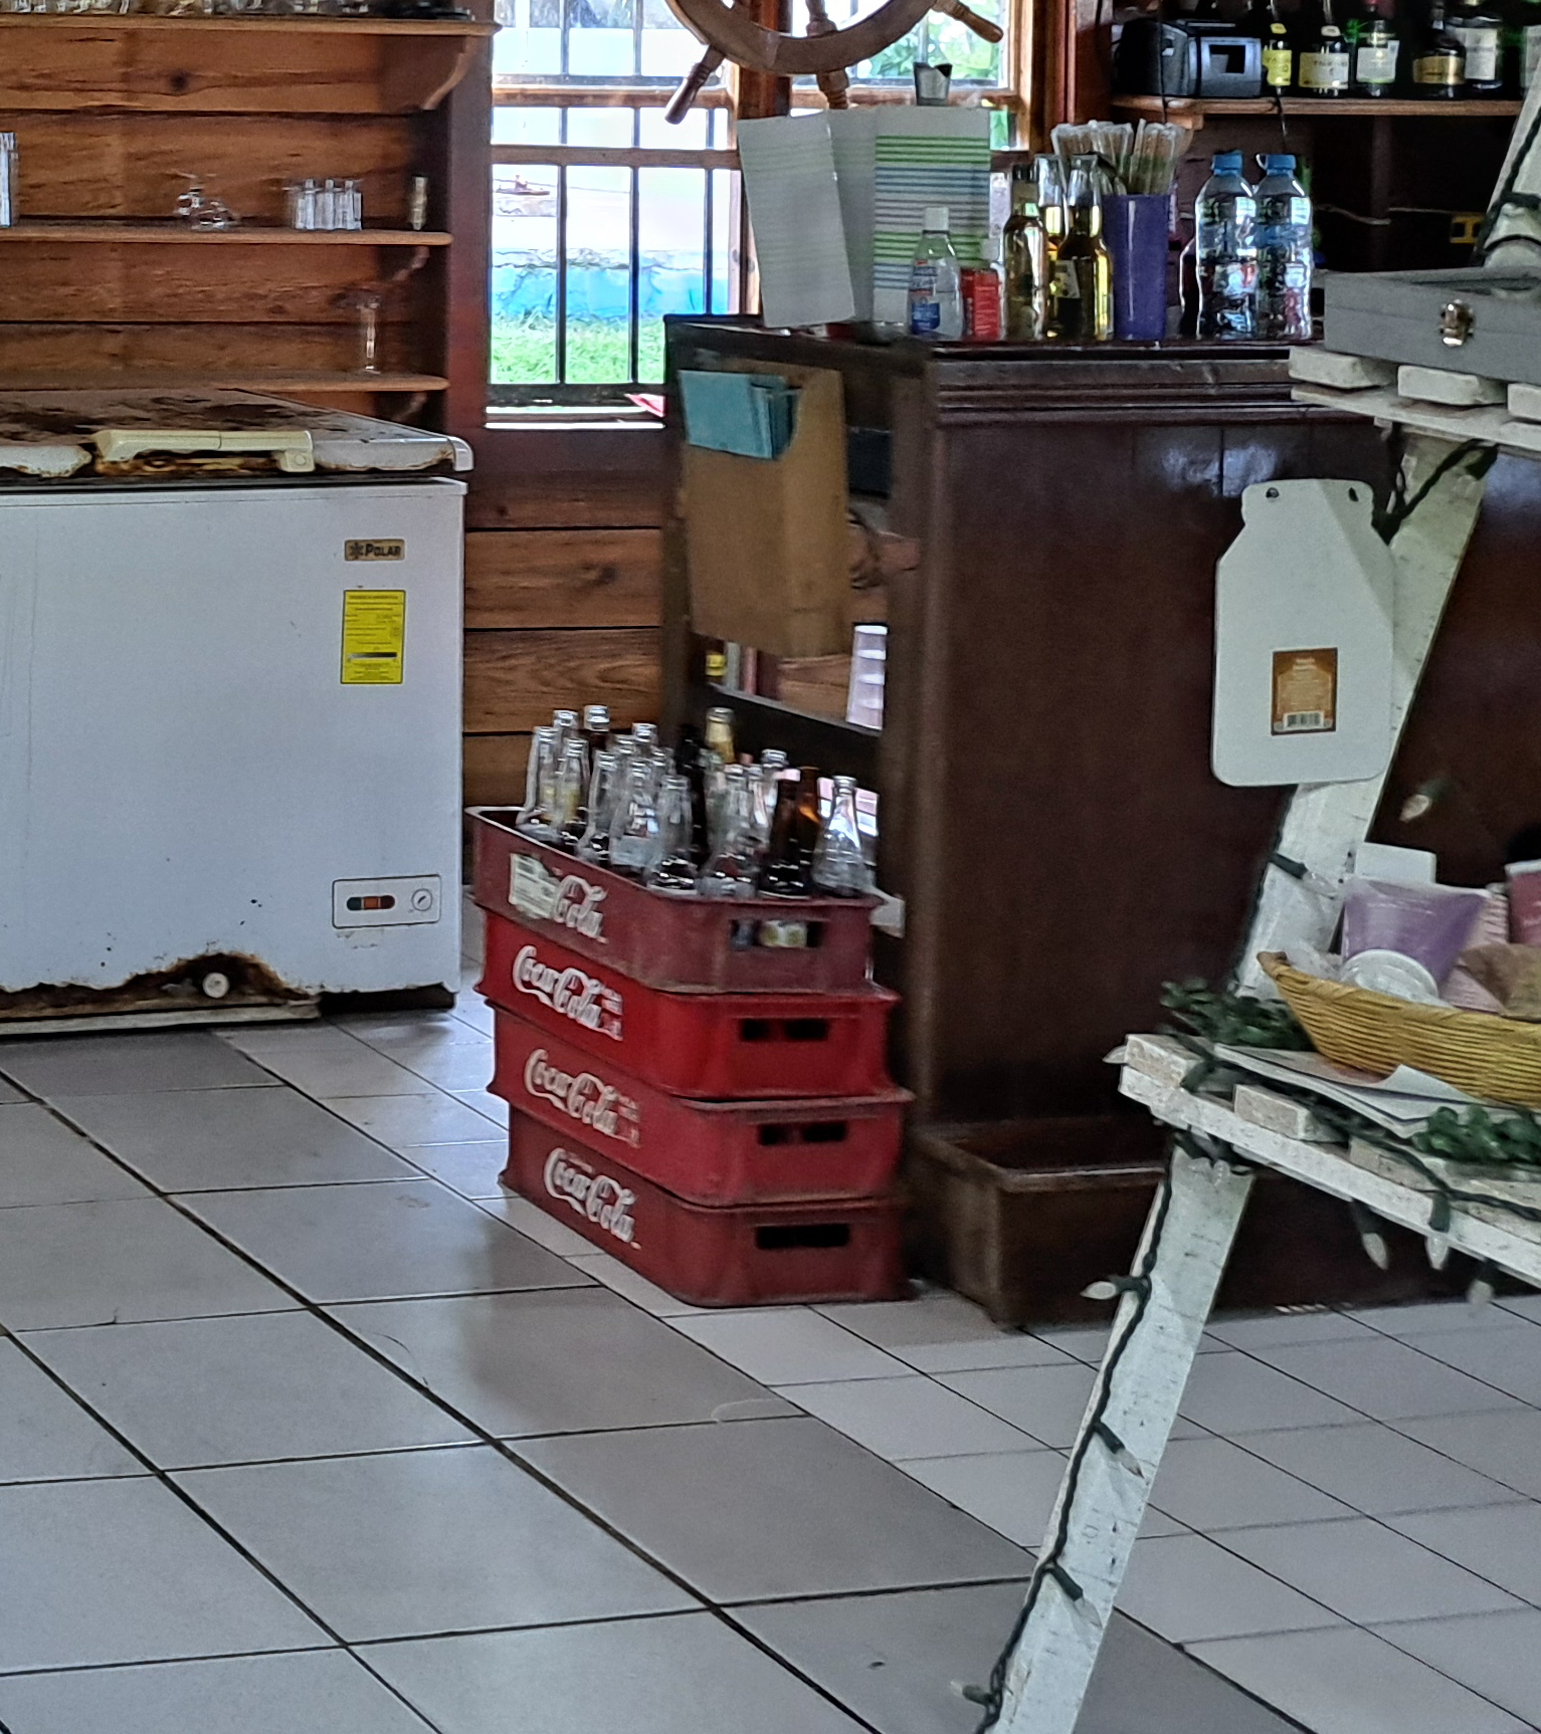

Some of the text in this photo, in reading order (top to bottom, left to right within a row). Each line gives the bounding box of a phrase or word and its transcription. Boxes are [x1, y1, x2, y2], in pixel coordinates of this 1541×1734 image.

[513, 944, 607, 1030] Coca-Cola
[524, 1048, 618, 1136] Coca-Cola
[544, 1147, 637, 1243] Coca-Cola
